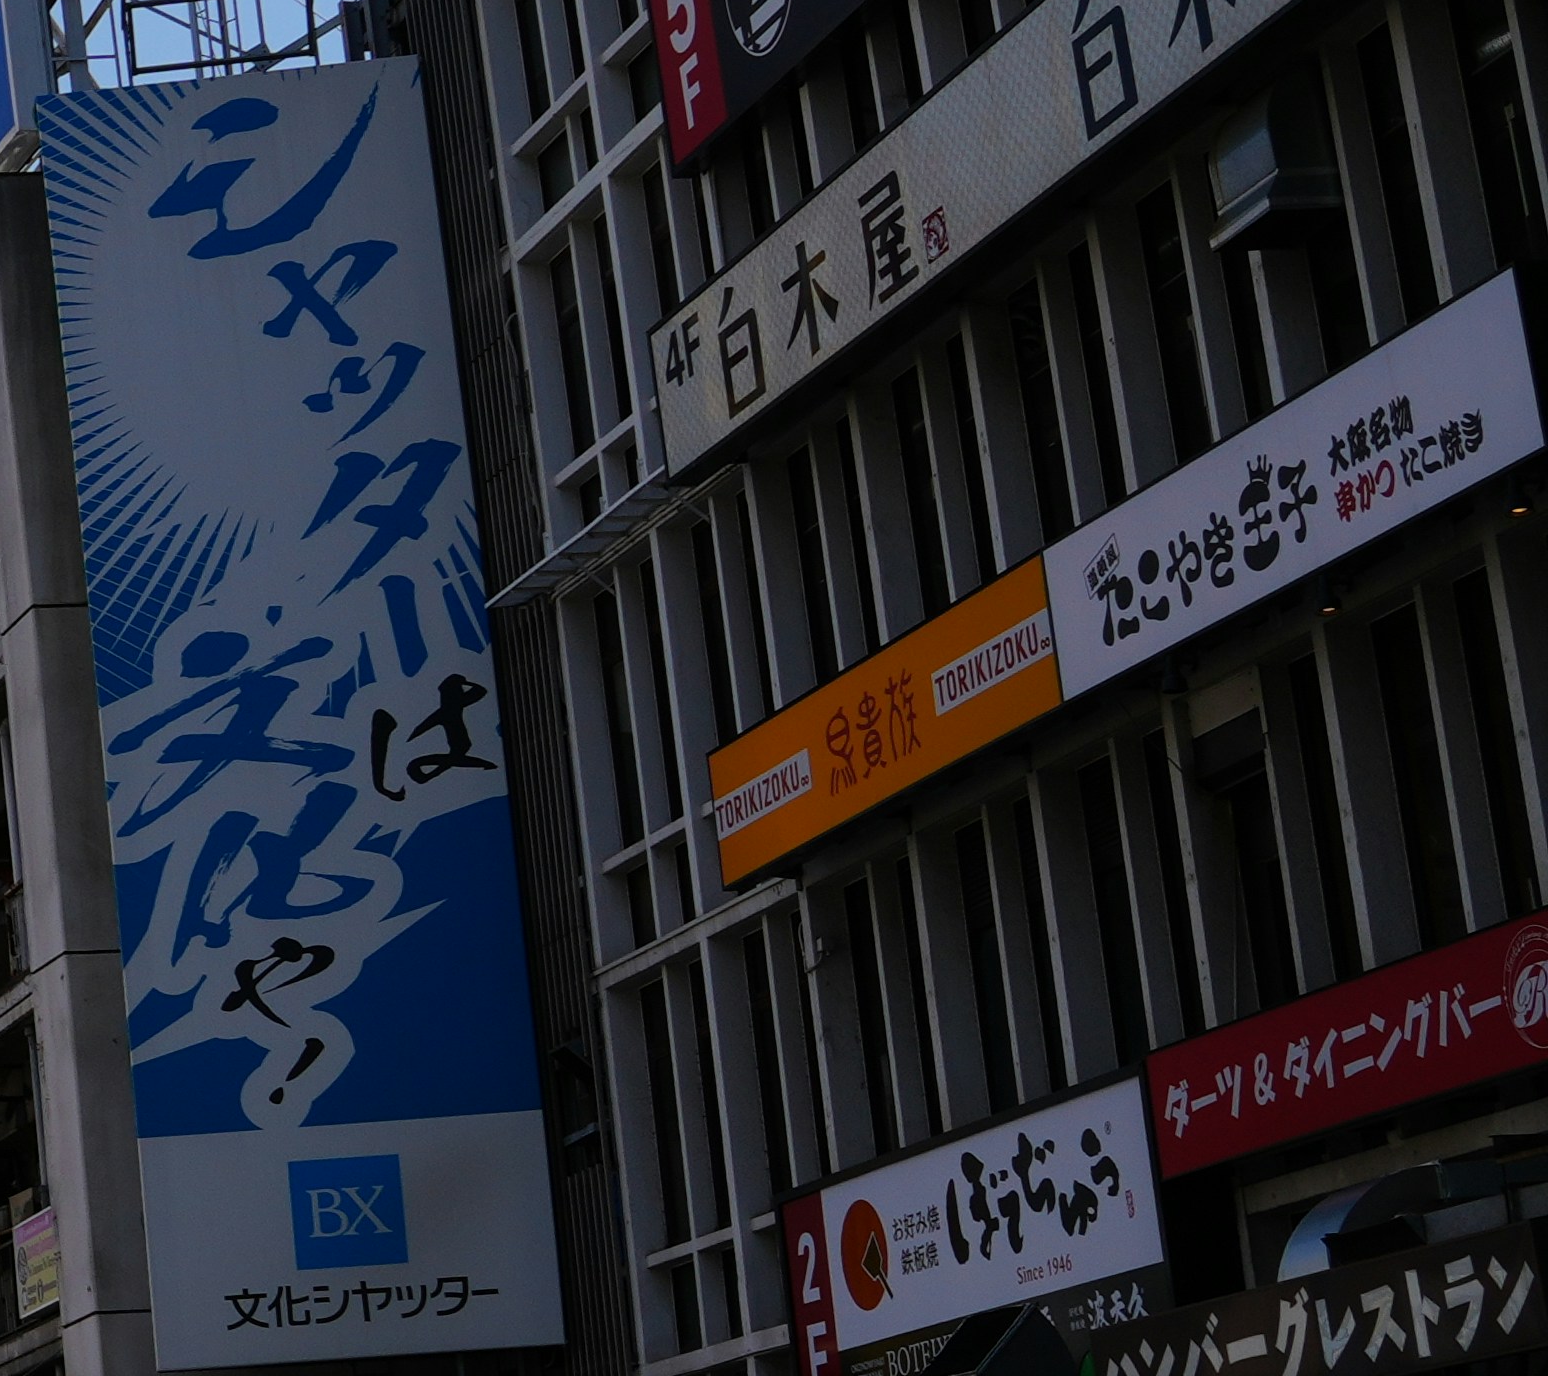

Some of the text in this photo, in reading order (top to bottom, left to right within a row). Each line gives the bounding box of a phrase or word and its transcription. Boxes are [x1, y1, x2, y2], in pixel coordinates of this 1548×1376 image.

[664, 169, 920, 420] 4F 白木屋
[1327, 394, 1413, 477] 大阪名物
[1333, 408, 1484, 523] 串かつ たこ焼き
[1096, 457, 1318, 647] たこやき王子
[934, 624, 1040, 707] TORIKIZOKU
[826, 668, 924, 796] 鳥貴族
[714, 748, 801, 833] TORIKIZOKU
[1163, 984, 1503, 1139] ダーツ&ダイニングバー
[306, 1184, 392, 1241] BX
[891, 1205, 941, 1241] お好み焼
[946, 1126, 1122, 1266] ぼてぢゅう
[900, 1241, 940, 1277] 鉄板焼
[1016, 1253, 1074, 1286] Since 1946
